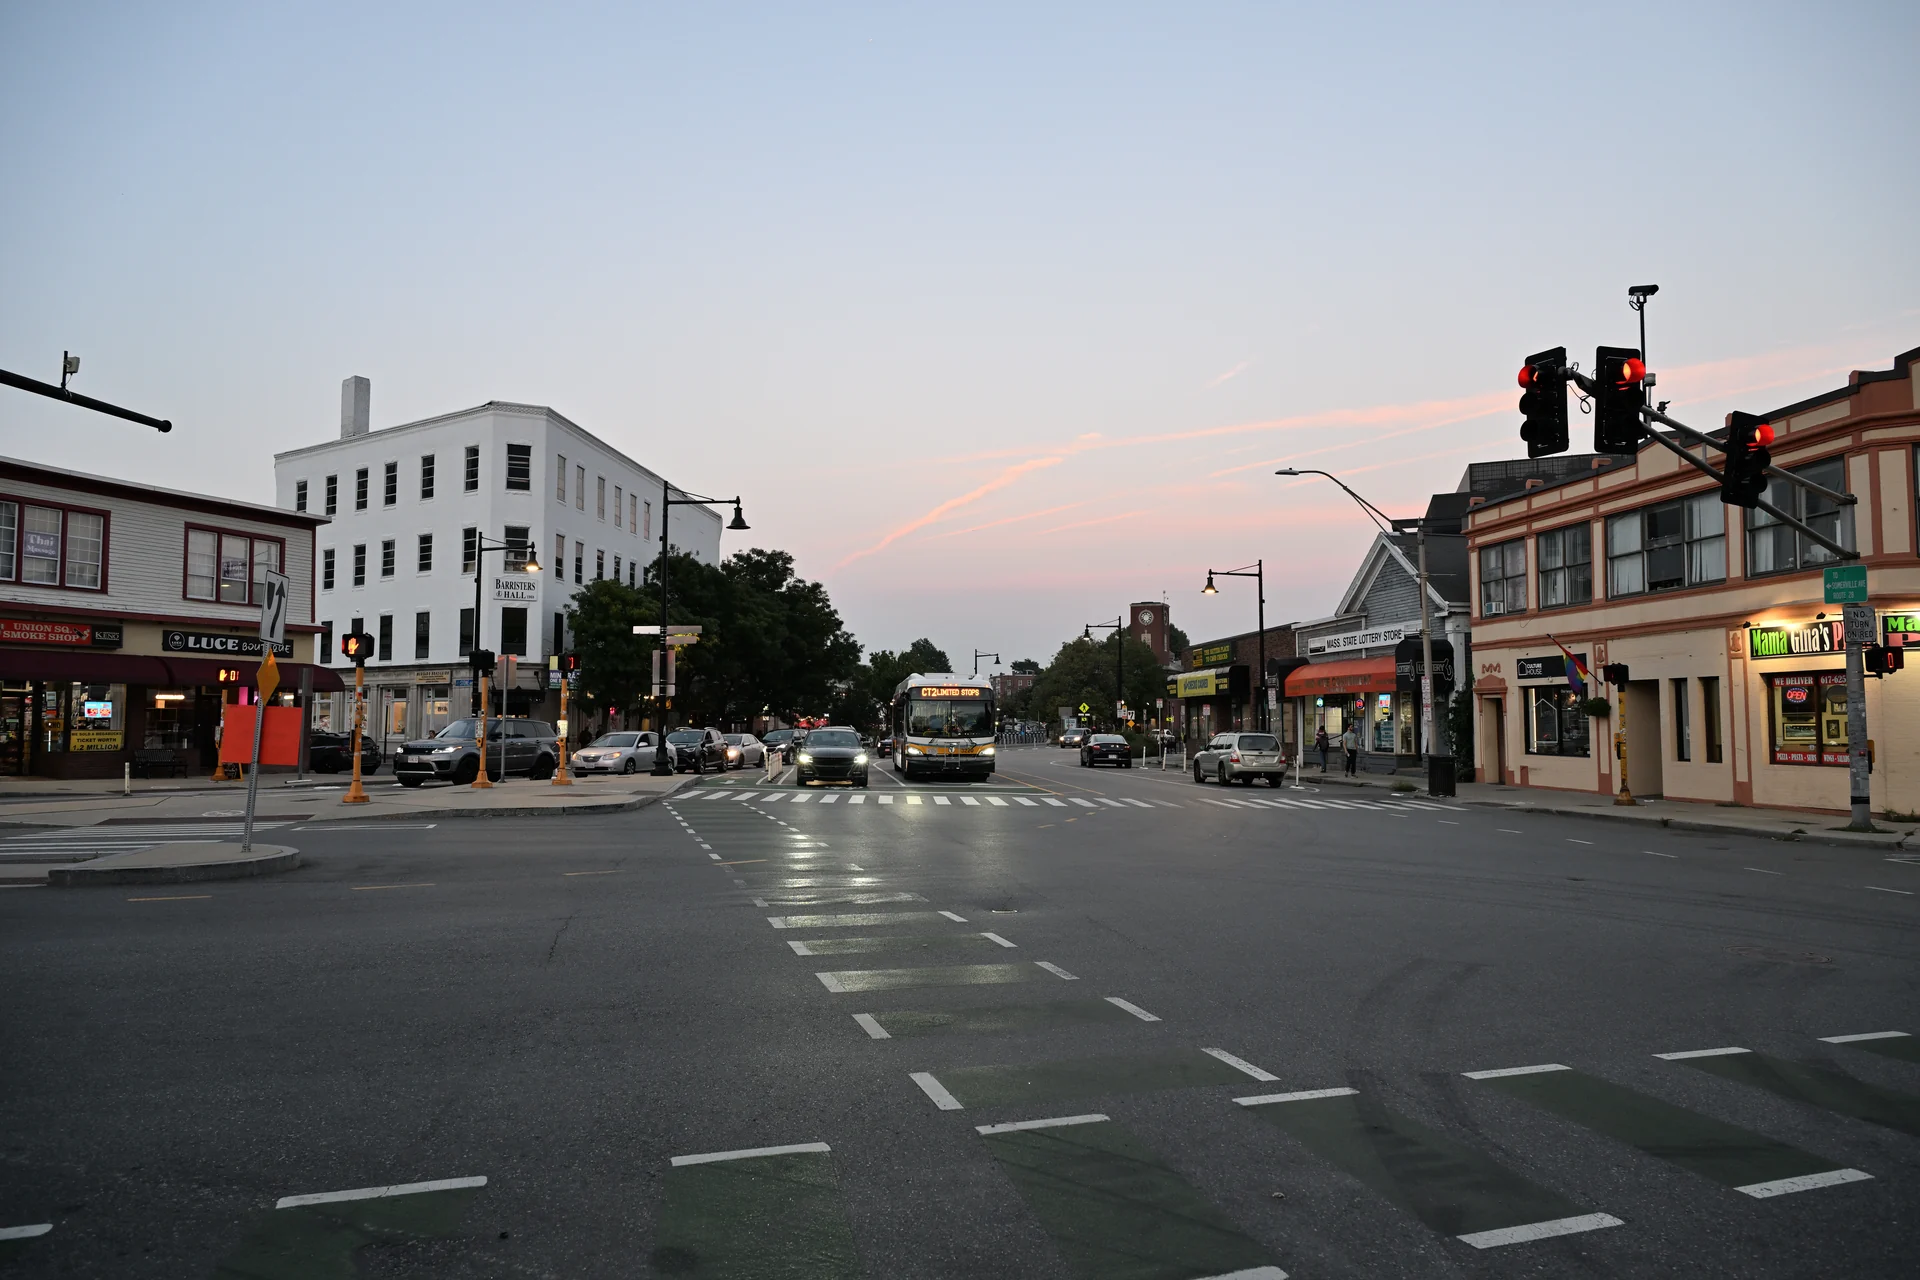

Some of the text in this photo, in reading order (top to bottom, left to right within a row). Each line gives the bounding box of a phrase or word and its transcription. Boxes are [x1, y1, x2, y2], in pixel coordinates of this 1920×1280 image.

[28, 534, 54, 546] Thai
[496, 579, 535, 590] BARRISTERS
[1832, 581, 1857, 589] SOMERVILLE
[13, 622, 52, 632] UNION
[3, 630, 79, 642] SMOKE SHOP
[95, 631, 119, 640] KENO
[1327, 629, 1402, 648] MASS. STATE LOTTERY STORE
[1752, 629, 1788, 656] Mama
[1791, 623, 1830, 654] Gina's
[188, 636, 291, 653] LUCE BOUTQUE
[1774, 676, 1813, 685] WE DELIVER
[922, 688, 937, 696] CT2
[1786, 691, 1806, 700] OPEN
